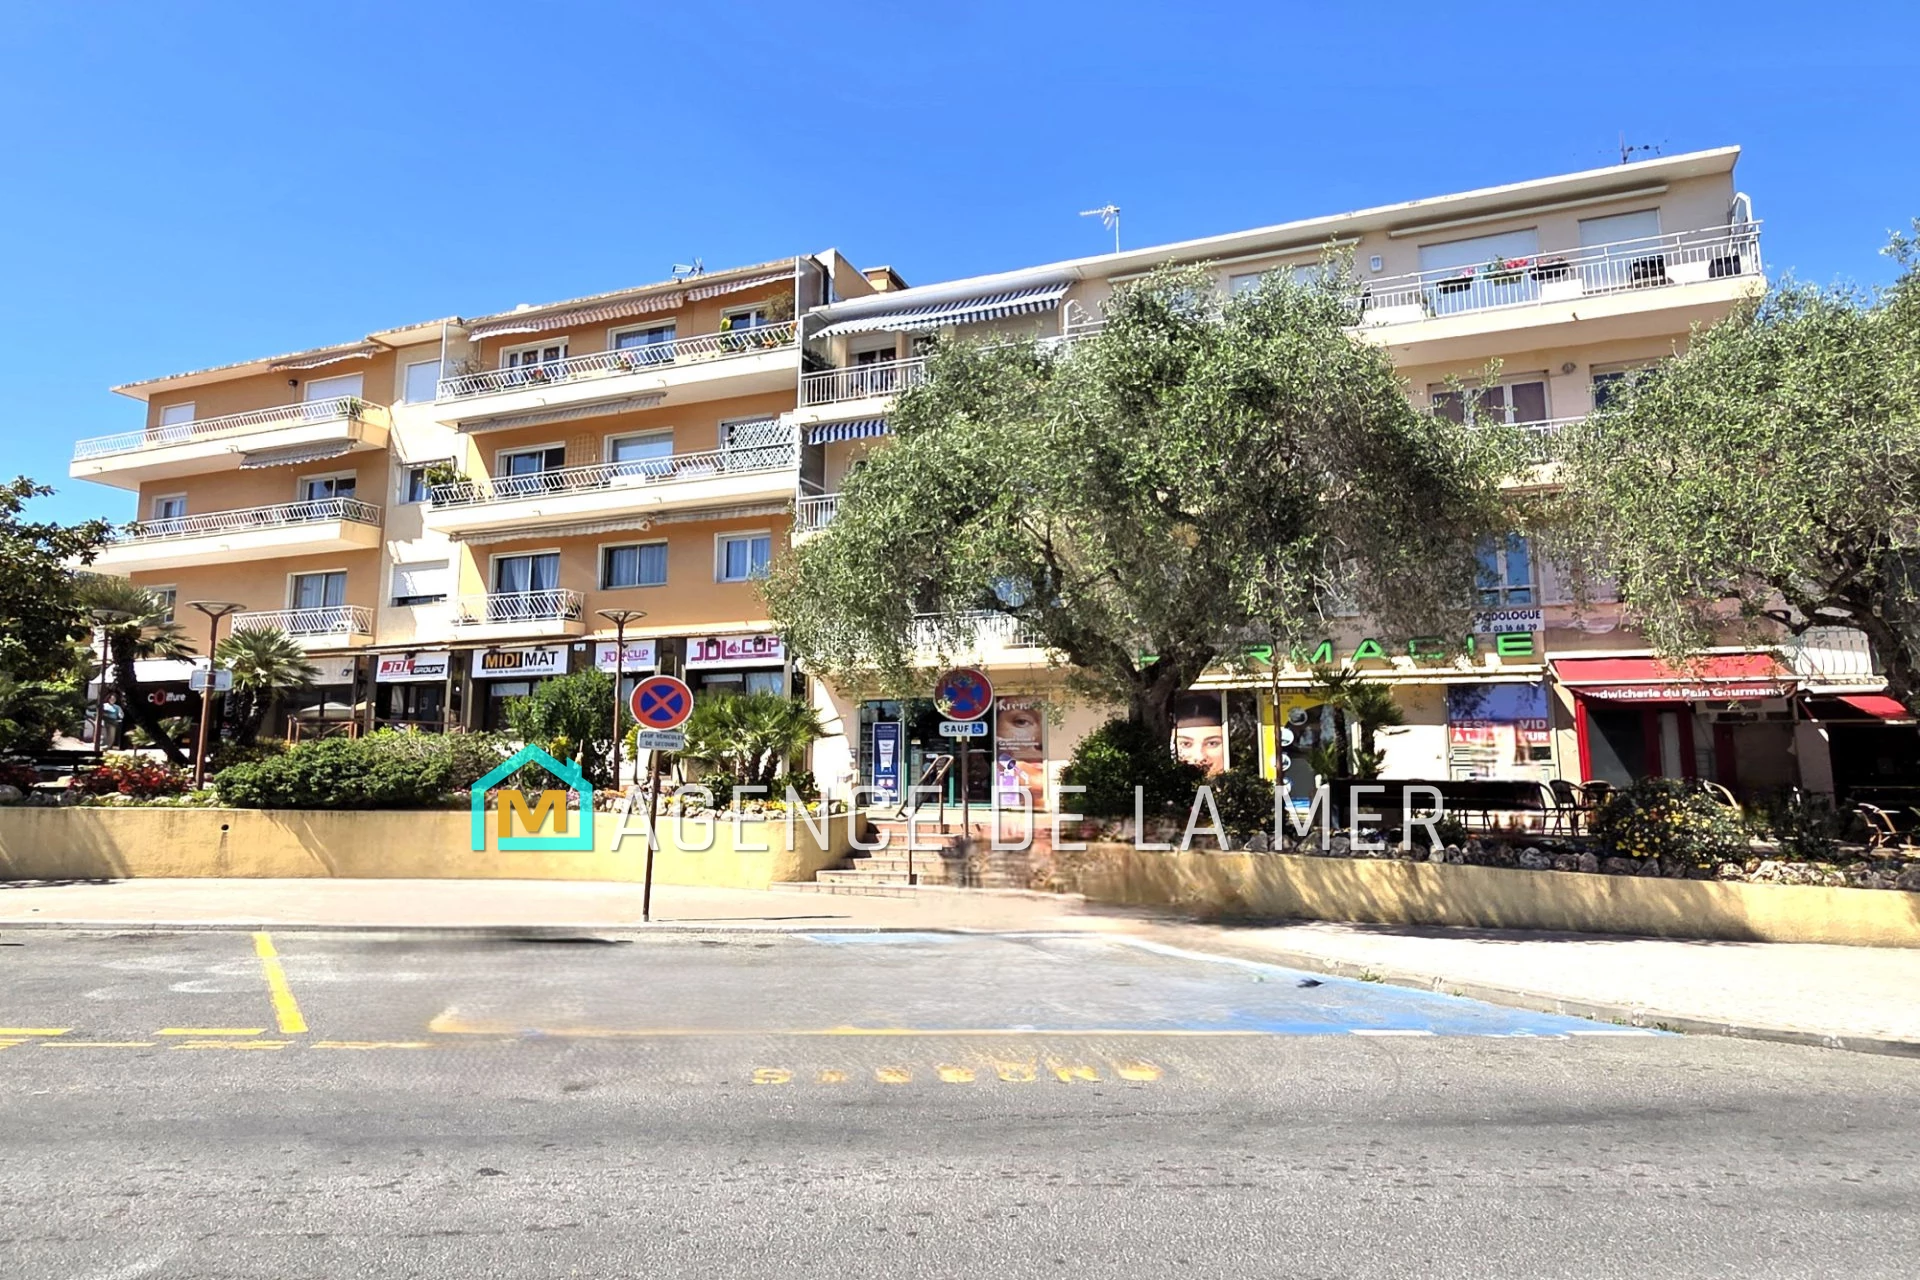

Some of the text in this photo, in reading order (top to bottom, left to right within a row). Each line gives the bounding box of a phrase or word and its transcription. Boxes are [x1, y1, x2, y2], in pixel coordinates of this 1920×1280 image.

[1477, 610, 1541, 621] PODOLOGUE
[691, 640, 728, 661] JDL
[1139, 631, 1534, 671] RMACIE
[485, 651, 559, 668] MIDI MAT
[413, 665, 445, 674] GROUPE
[1585, 688, 1661, 699] ndwicherie
[1663, 687, 1679, 698] du
[1682, 687, 1710, 698] Pain
[943, 724, 970, 733] SAUF
